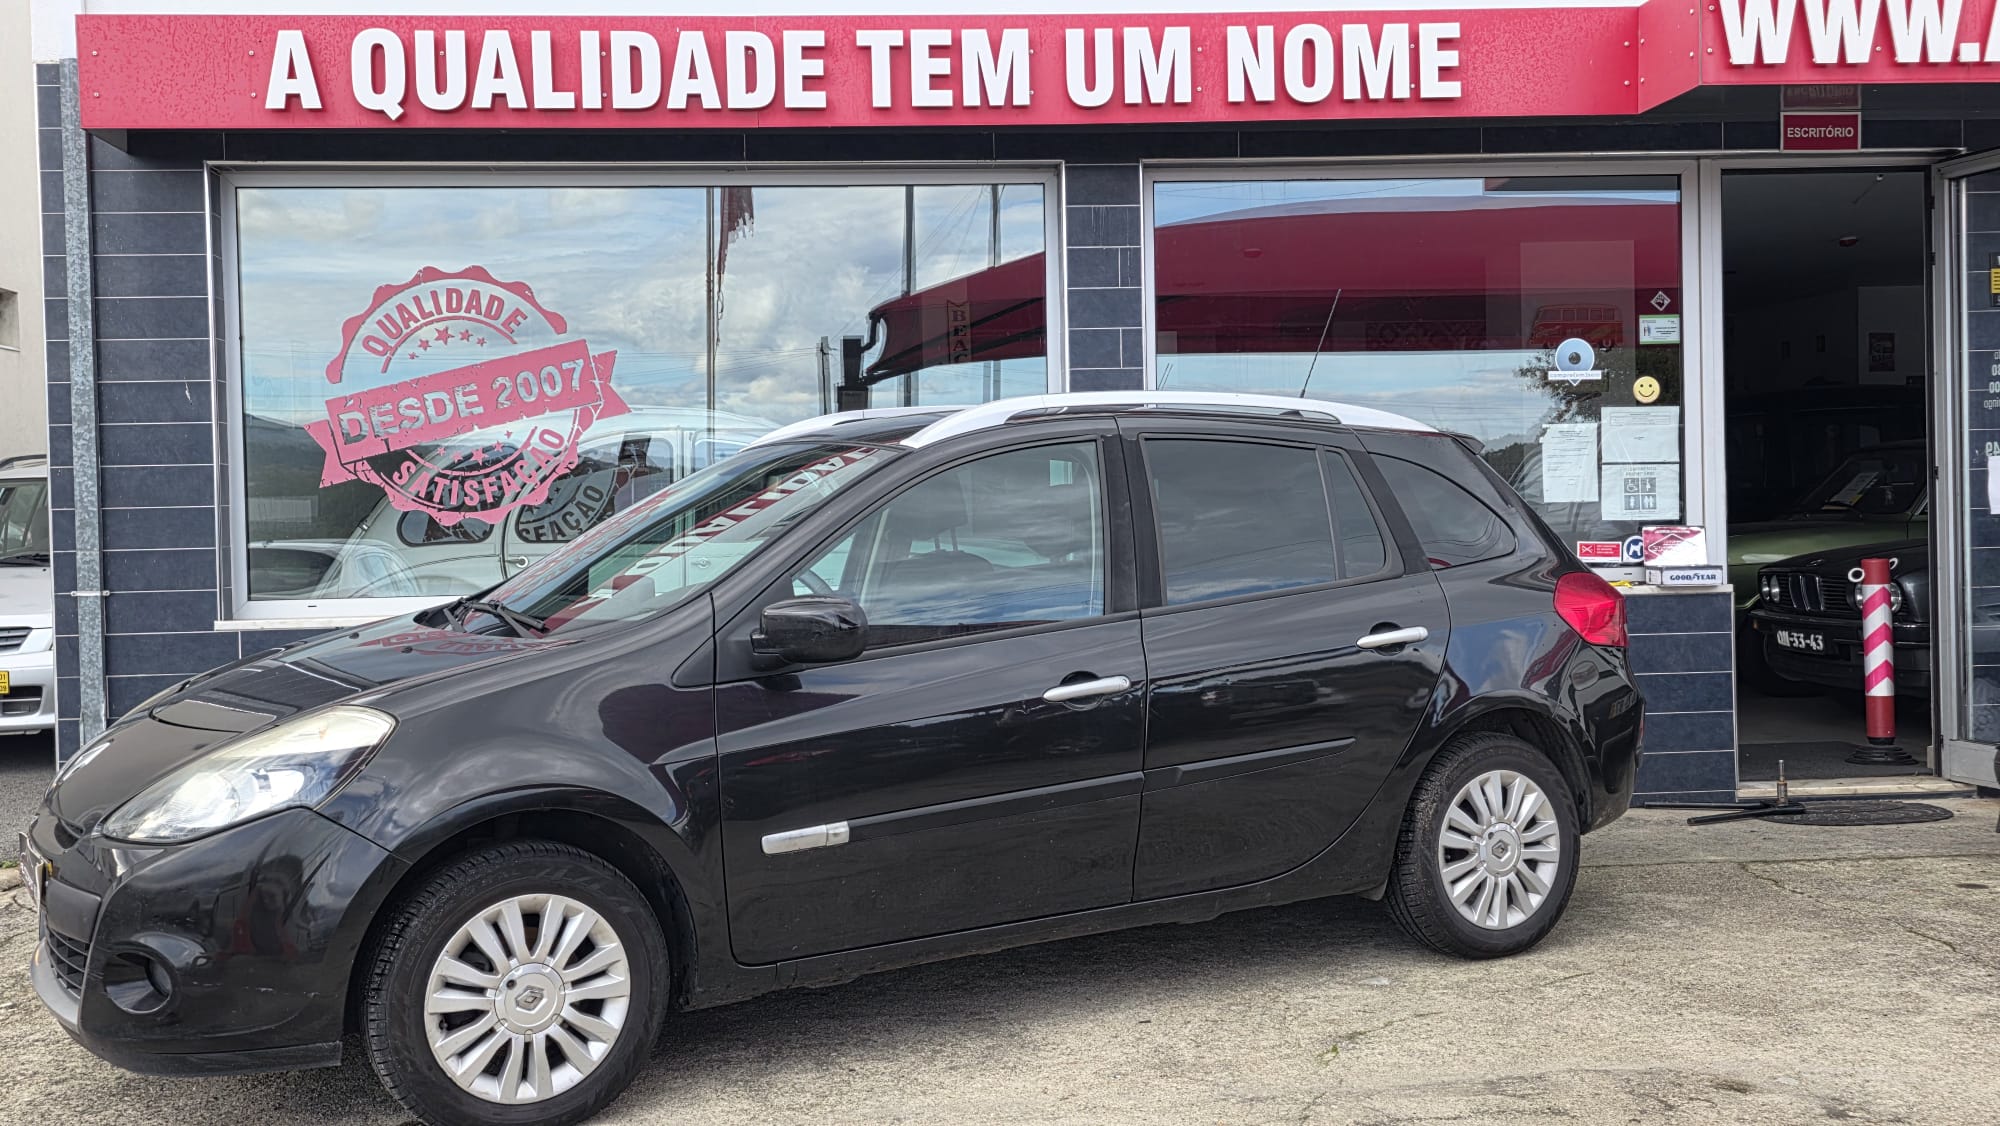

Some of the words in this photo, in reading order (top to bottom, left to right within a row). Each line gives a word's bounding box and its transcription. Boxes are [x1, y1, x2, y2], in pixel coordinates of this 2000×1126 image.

[1719, 0, 2000, 65] WWW.
[265, 30, 323, 109] A
[351, 28, 827, 121] QUALIDADE
[855, 28, 1030, 108] TEM
[1065, 26, 1192, 107] UM
[1227, 23, 1462, 104] NOME
[1787, 124, 1855, 138] ESCRITÓRIO
[361, 287, 528, 357] QUALIDADE
[338, 382, 485, 446] DESDE
[491, 358, 585, 410] 2007
[1670, 572, 1717, 581] GOODYEAR
